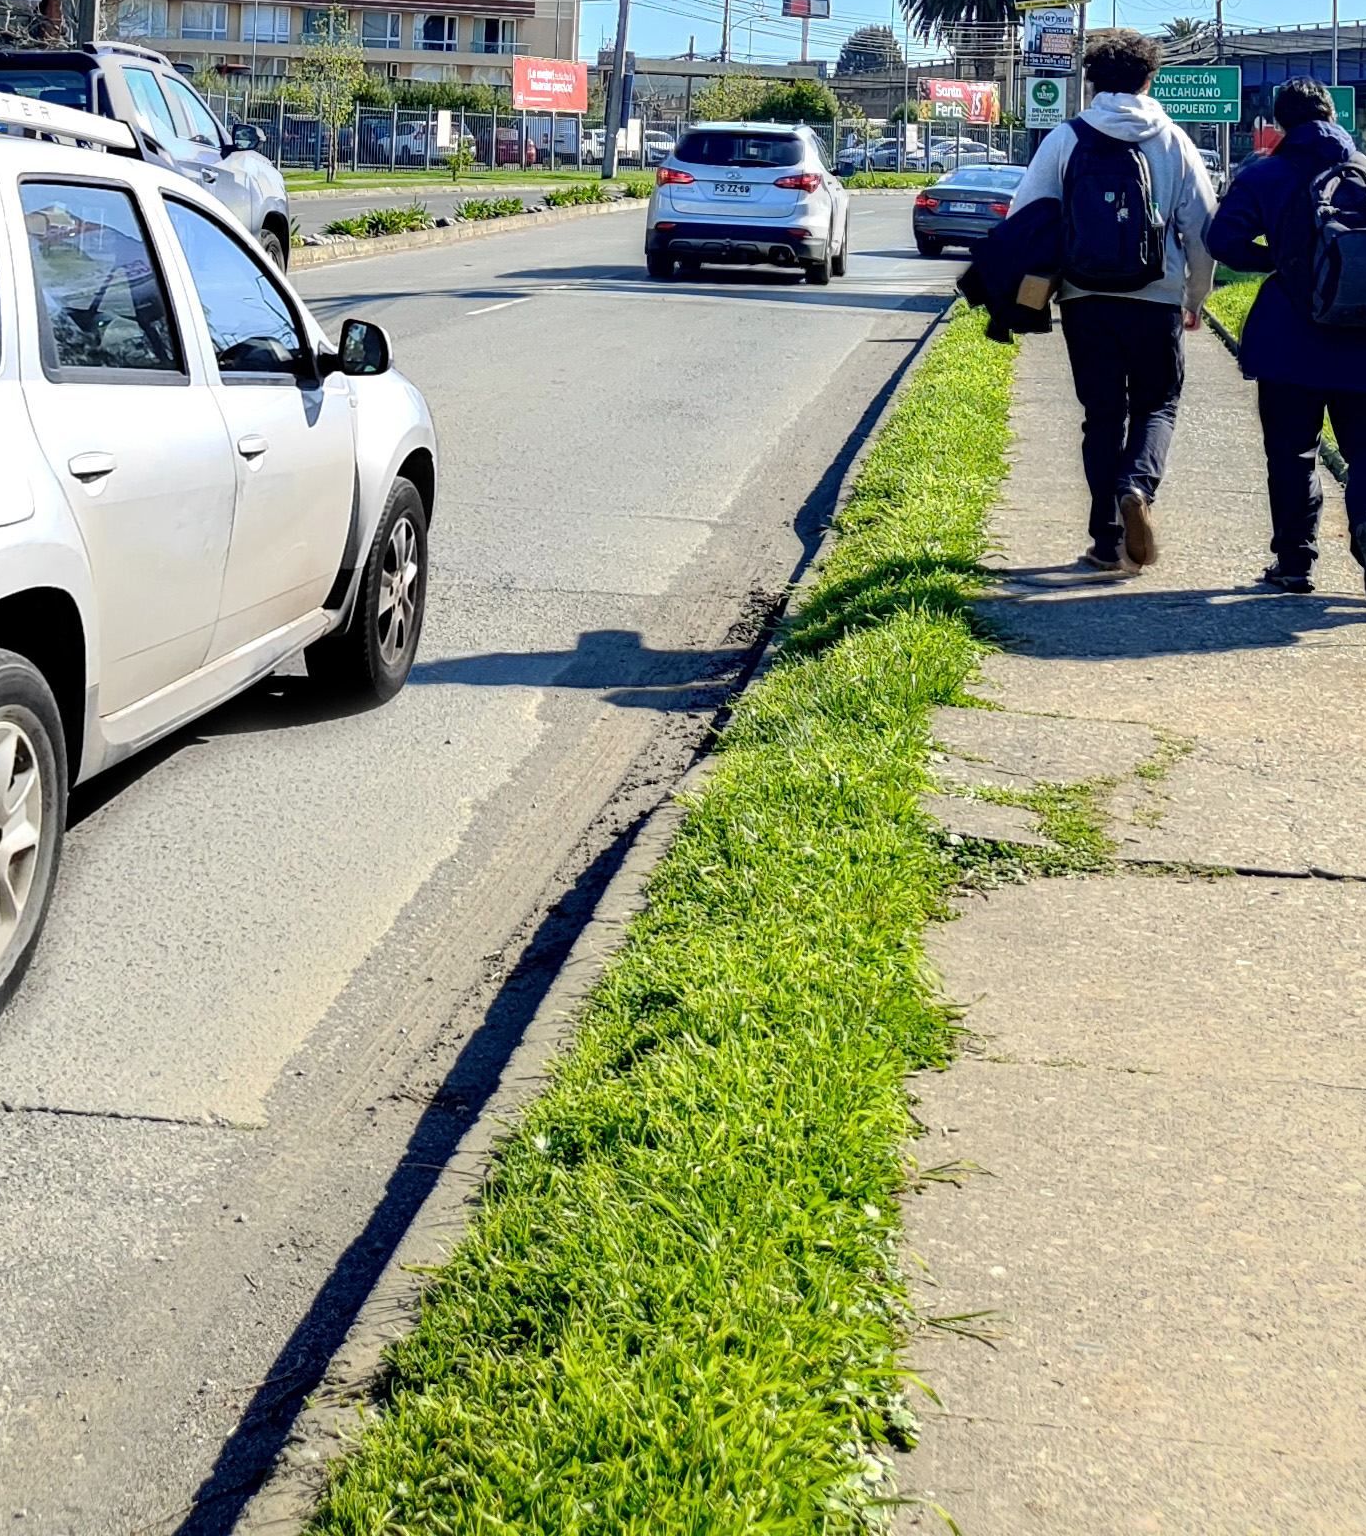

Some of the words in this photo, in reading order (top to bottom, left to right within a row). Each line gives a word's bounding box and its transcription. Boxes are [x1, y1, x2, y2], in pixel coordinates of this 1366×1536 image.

[1153, 72, 1217, 84] CONCEPCIÓN
[935, 84, 963, 97] Santa
[1153, 87, 1221, 97] TALCAHUANO
[935, 101, 963, 117] Feria
[1161, 103, 1217, 114] EROPUERTO
